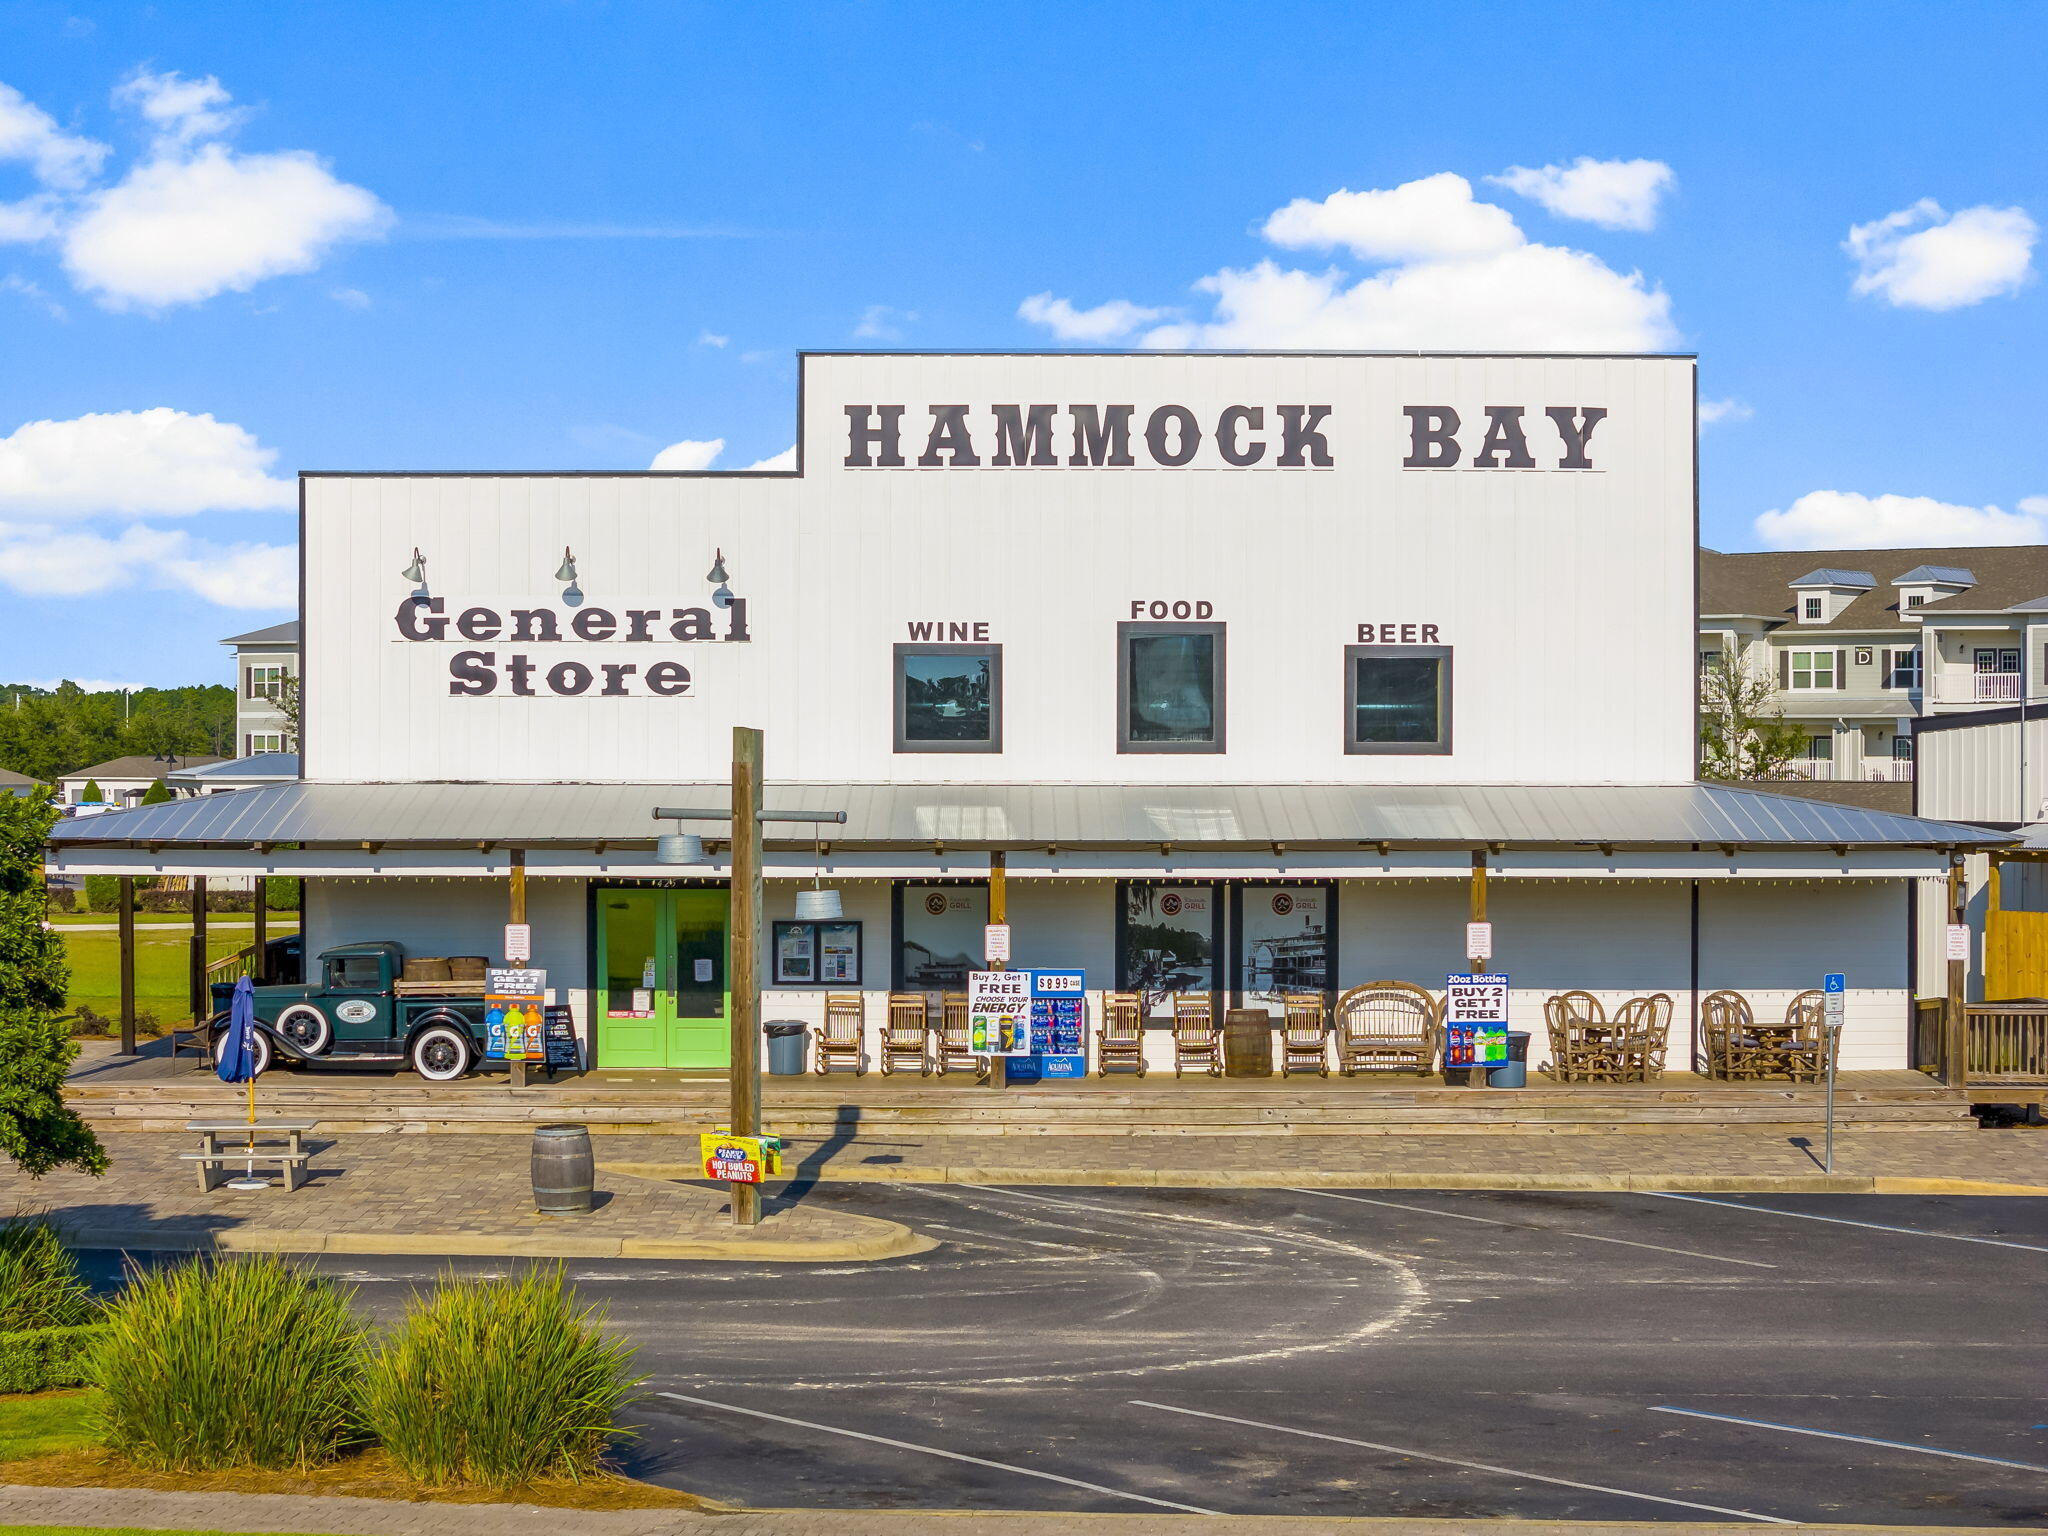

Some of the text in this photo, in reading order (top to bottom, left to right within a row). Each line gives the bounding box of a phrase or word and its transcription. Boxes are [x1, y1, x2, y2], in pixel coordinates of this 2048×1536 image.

[843, 404, 1607, 468] HAMMOCK BAY
[1131, 600, 1213, 620] FOOD
[394, 597, 750, 641] General
[908, 622, 990, 642] WINE
[1357, 624, 1440, 644] BEER
[1859, 652, 1870, 664] D
[449, 651, 691, 695] Store
[972, 973, 989, 982] Buy
[992, 973, 1001, 982] 2,
[1448, 974, 1507, 984] 20oz Bottles
[979, 984, 1021, 994] FREE
[1452, 988, 1503, 997] BUY 2
[972, 1003, 1026, 1013] ENERGY
[1455, 999, 1501, 1008] GET 1
[1455, 1010, 1500, 1019] FREE
[1048, 1062, 1073, 1071] AQUAFINA
[712, 1160, 754, 1172] HOT BOILED
[716, 1170, 752, 1180] PEANUTS
